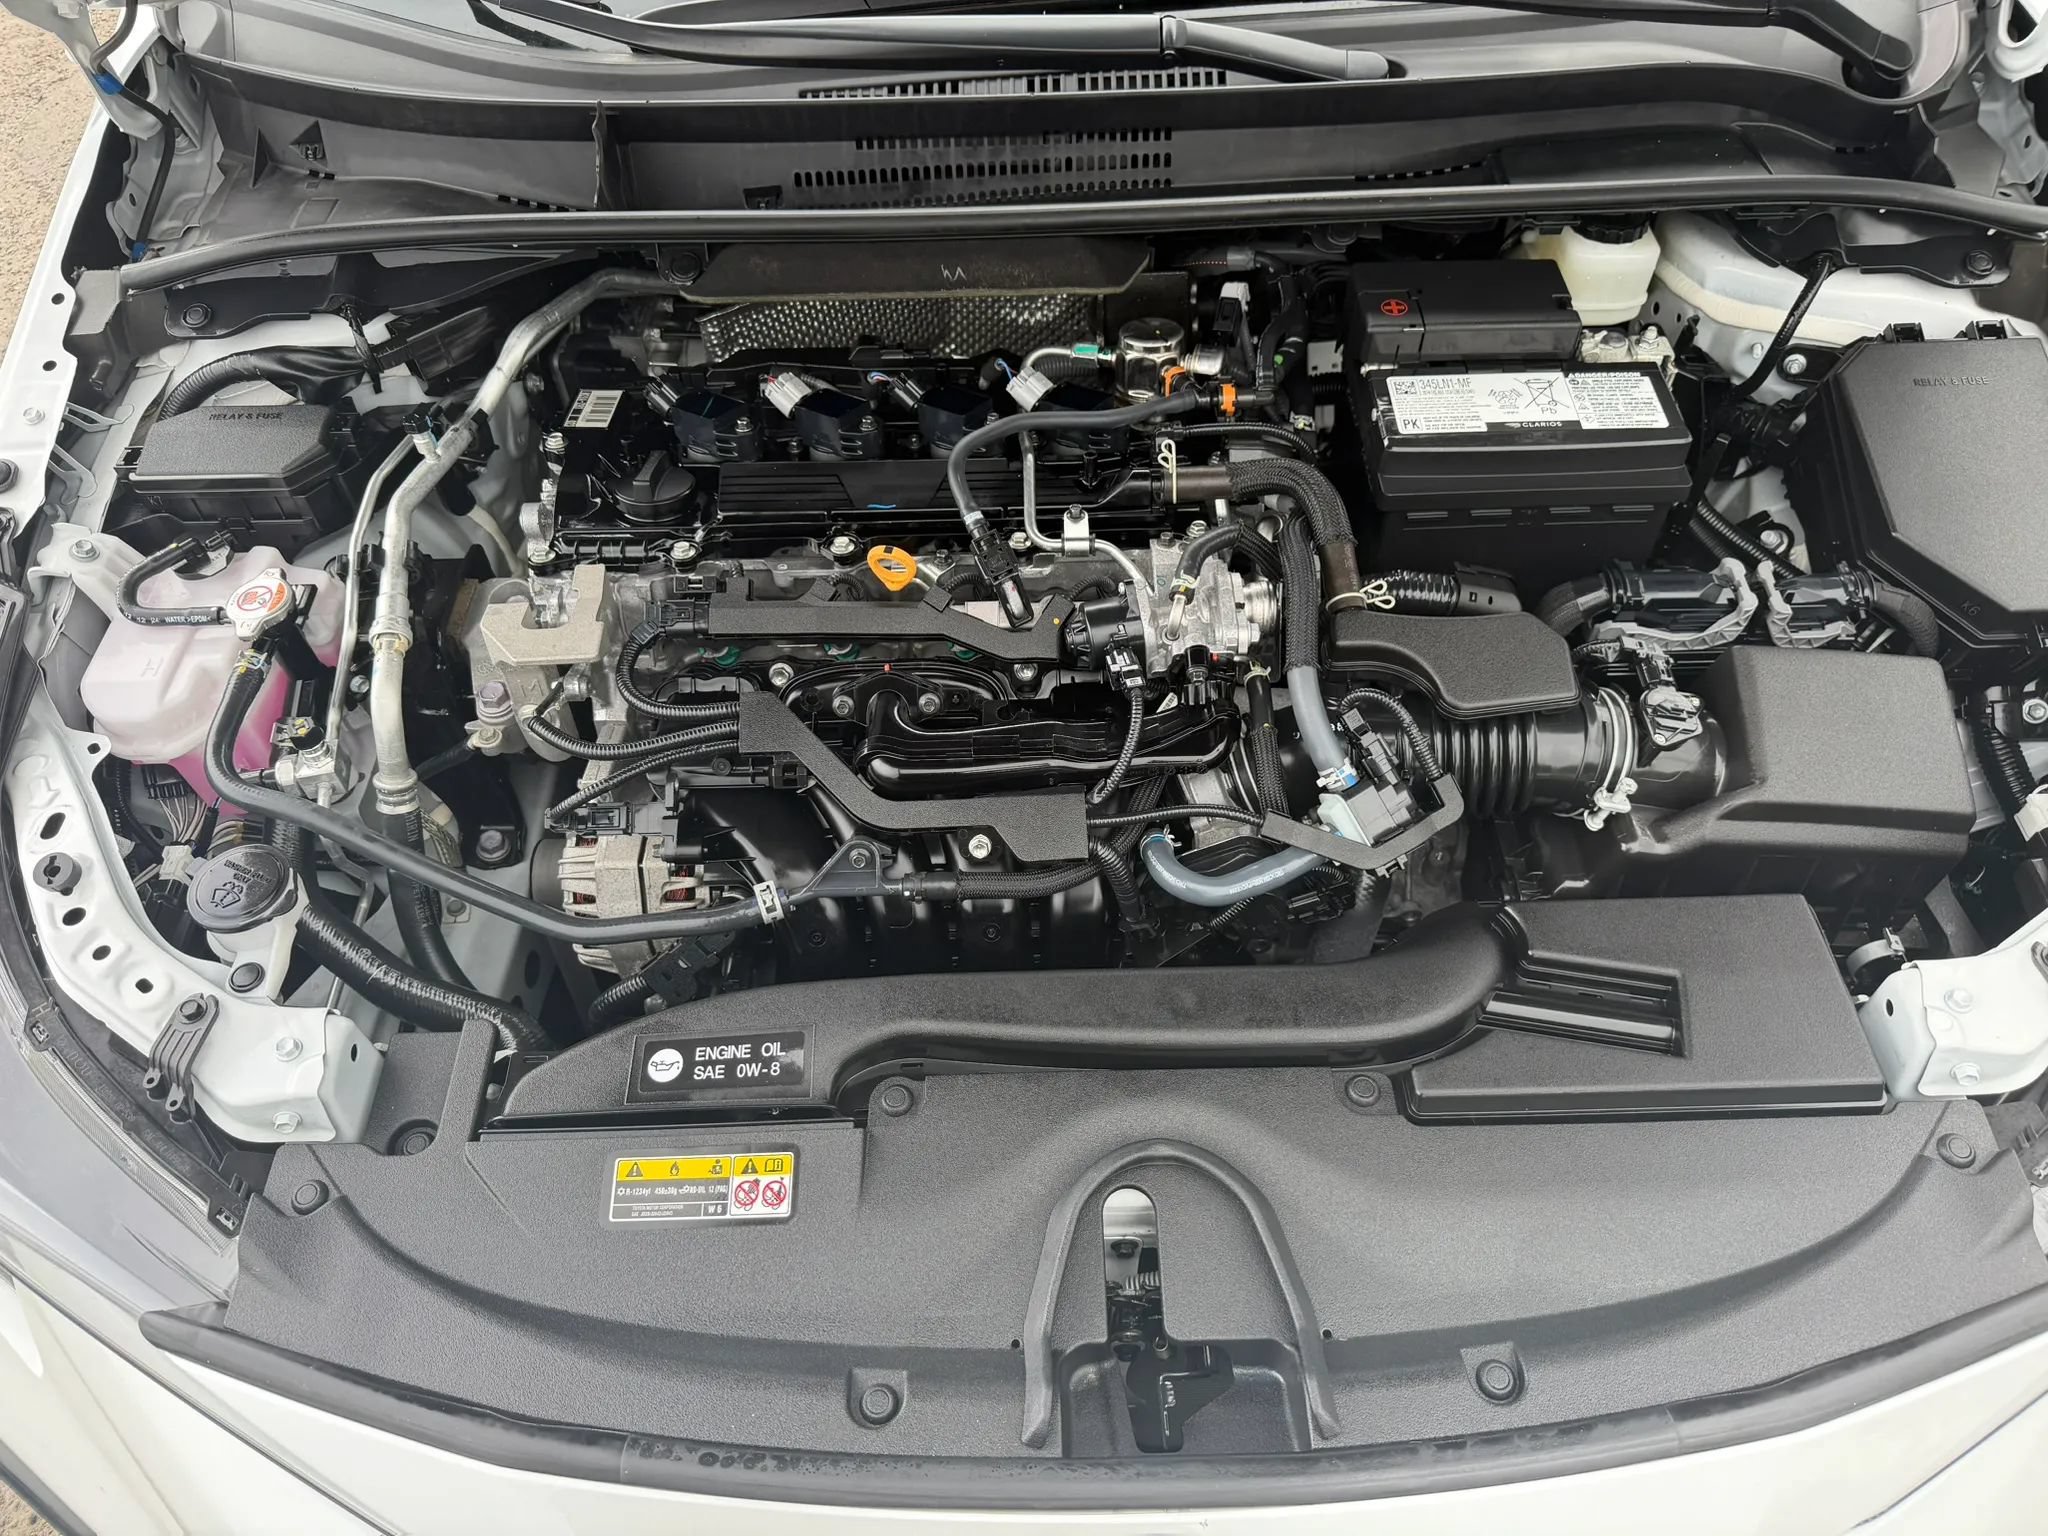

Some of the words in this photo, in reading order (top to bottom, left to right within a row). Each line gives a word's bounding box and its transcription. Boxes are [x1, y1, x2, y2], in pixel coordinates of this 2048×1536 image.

[1420, 377, 1472, 391] 345LN1-MF
[1913, 376, 1946, 386] RELAY
[1960, 375, 1990, 386] FUSE
[1540, 406, 1558, 415] Pb
[208, 413, 244, 421] RELAY
[255, 412, 283, 420] FUSE
[1402, 419, 1421, 430] PK
[695, 1043, 752, 1061] ENGINE
[761, 1041, 787, 1058] OIL
[693, 1065, 726, 1080] SAE
[736, 1061, 781, 1078] 0W-8
[708, 1205, 716, 1213] W
[717, 1204, 723, 1213] 6
